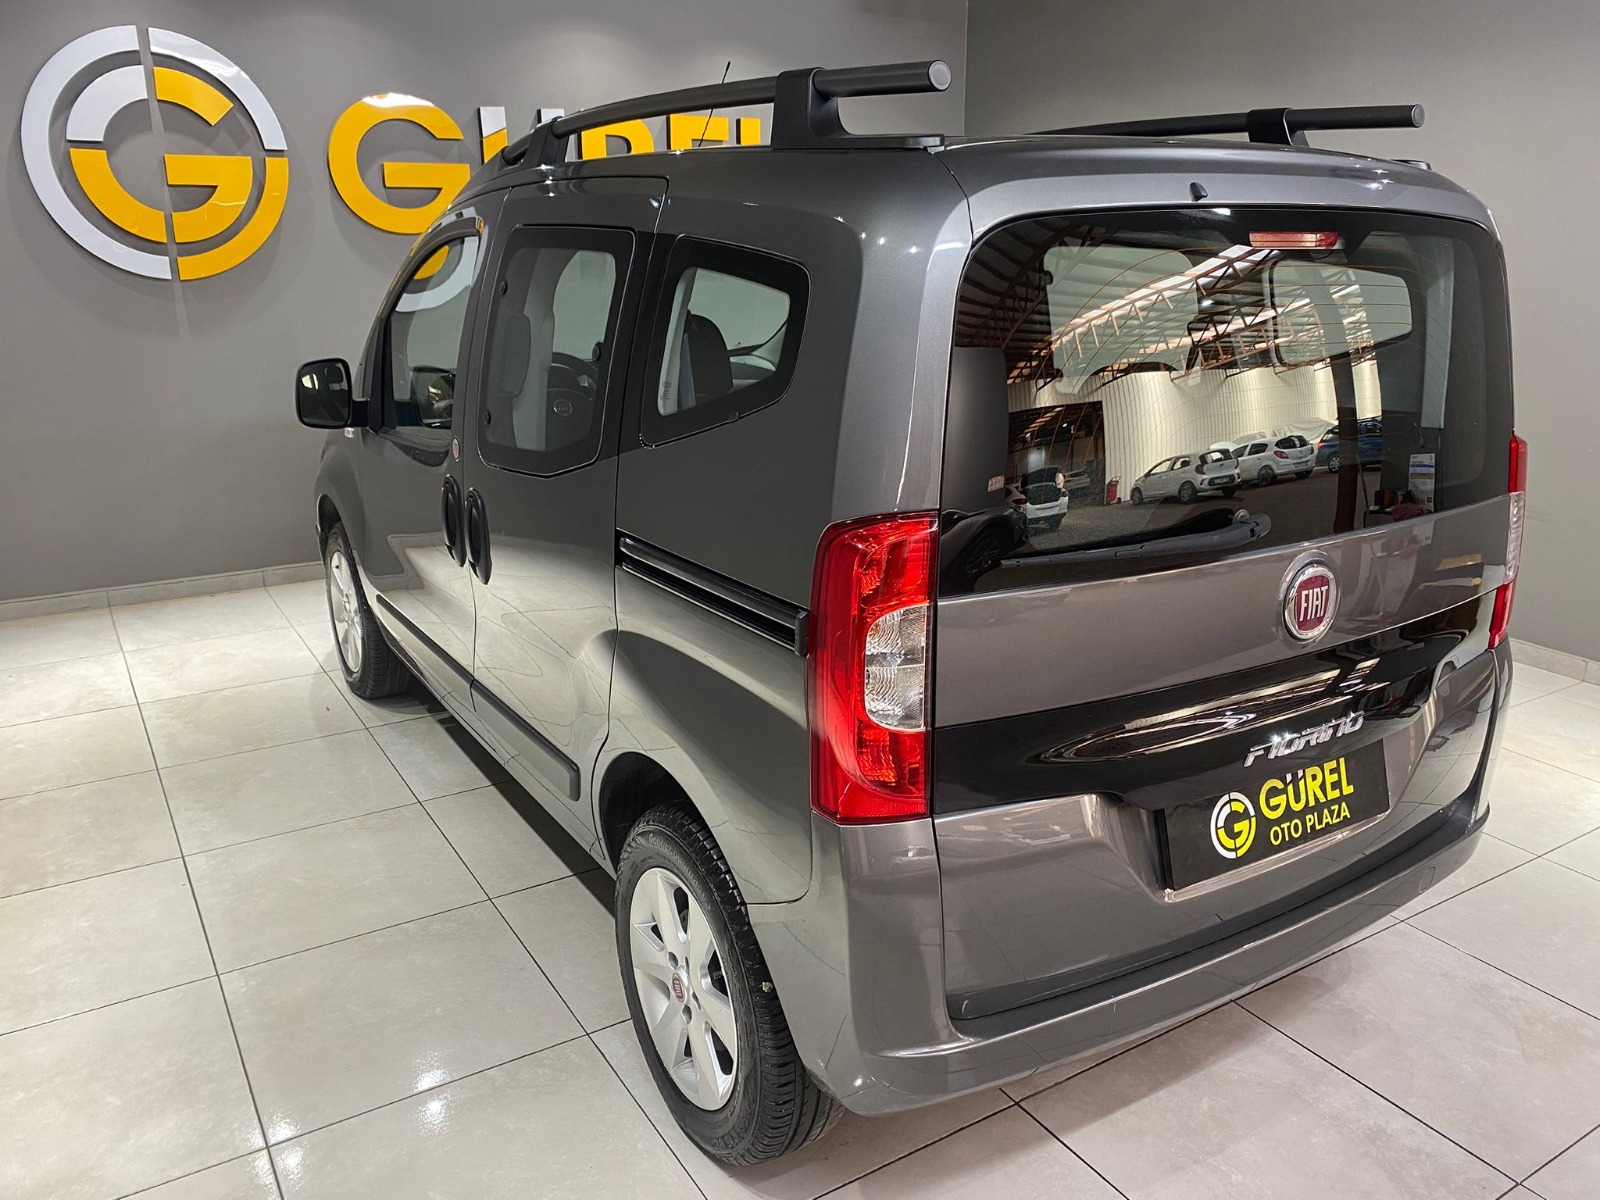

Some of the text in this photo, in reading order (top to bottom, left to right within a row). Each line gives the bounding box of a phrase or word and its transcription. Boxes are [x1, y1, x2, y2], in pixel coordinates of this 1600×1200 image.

[1299, 585, 1328, 622] FIAT
[1270, 801, 1351, 846] OTO PLAZA
